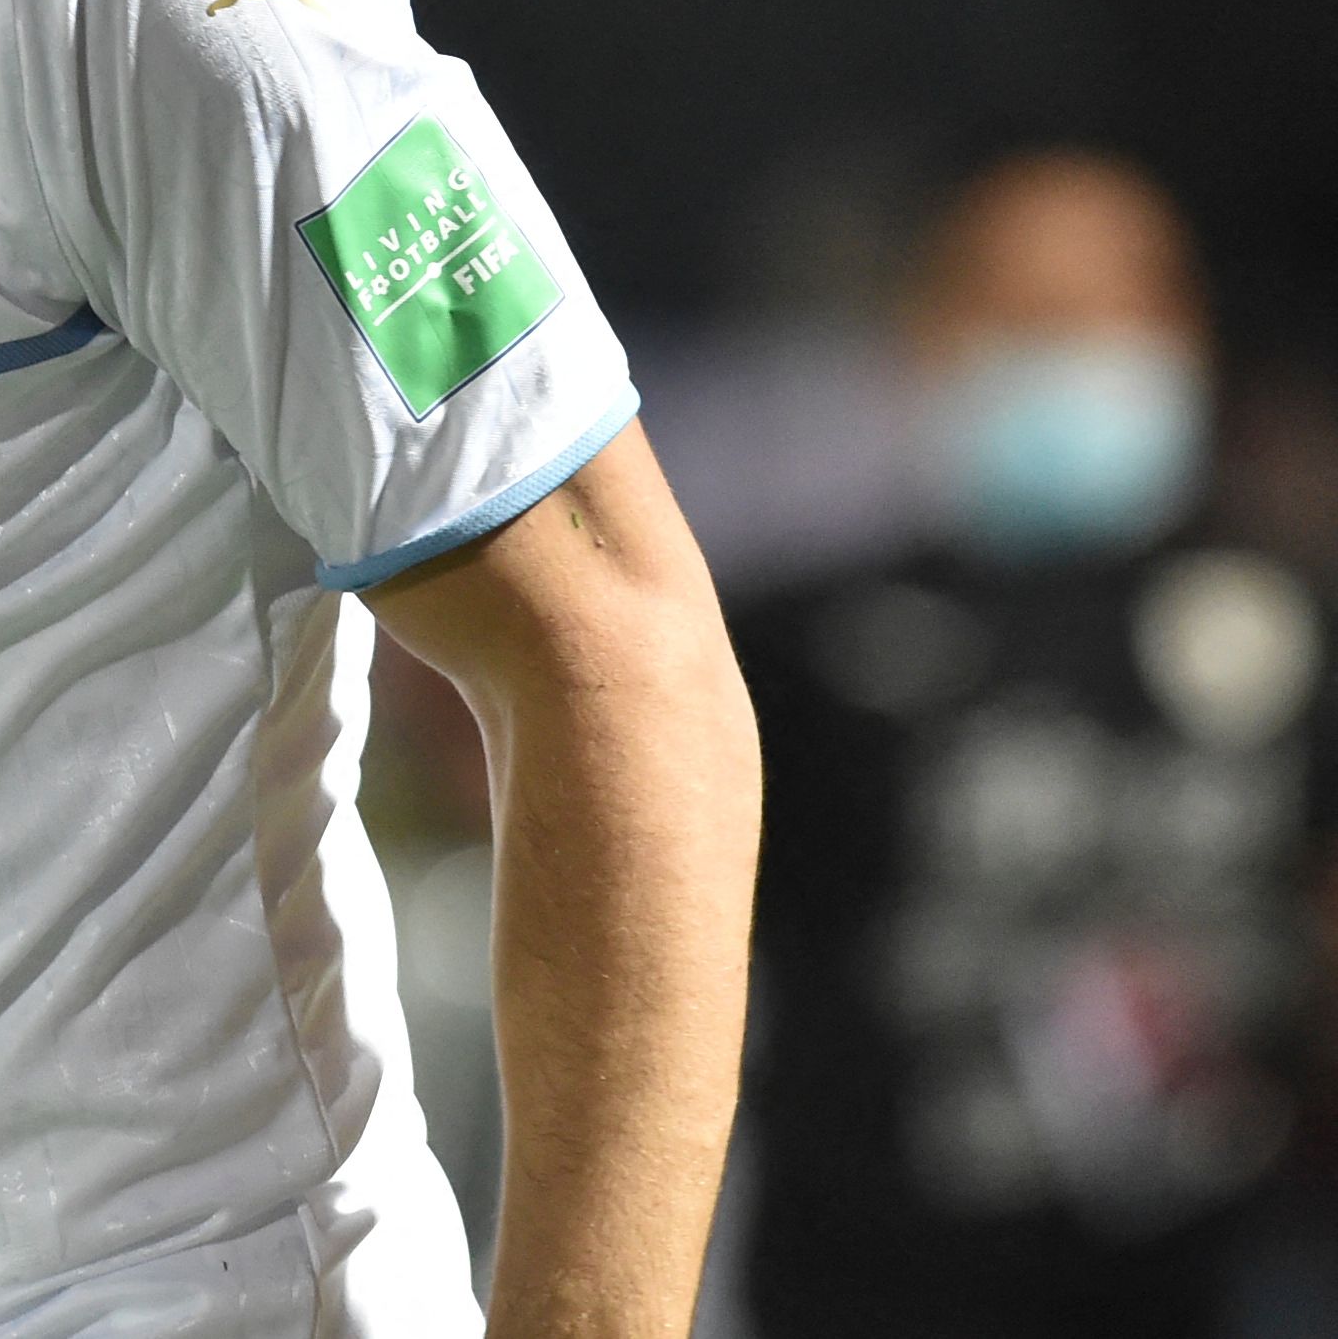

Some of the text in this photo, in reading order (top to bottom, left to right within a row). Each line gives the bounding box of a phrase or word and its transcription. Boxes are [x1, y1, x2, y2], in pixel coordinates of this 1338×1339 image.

[345, 167, 472, 290] LIVING
[357, 192, 486, 311] FOOTBALL
[451, 229, 520, 296] FIFA
